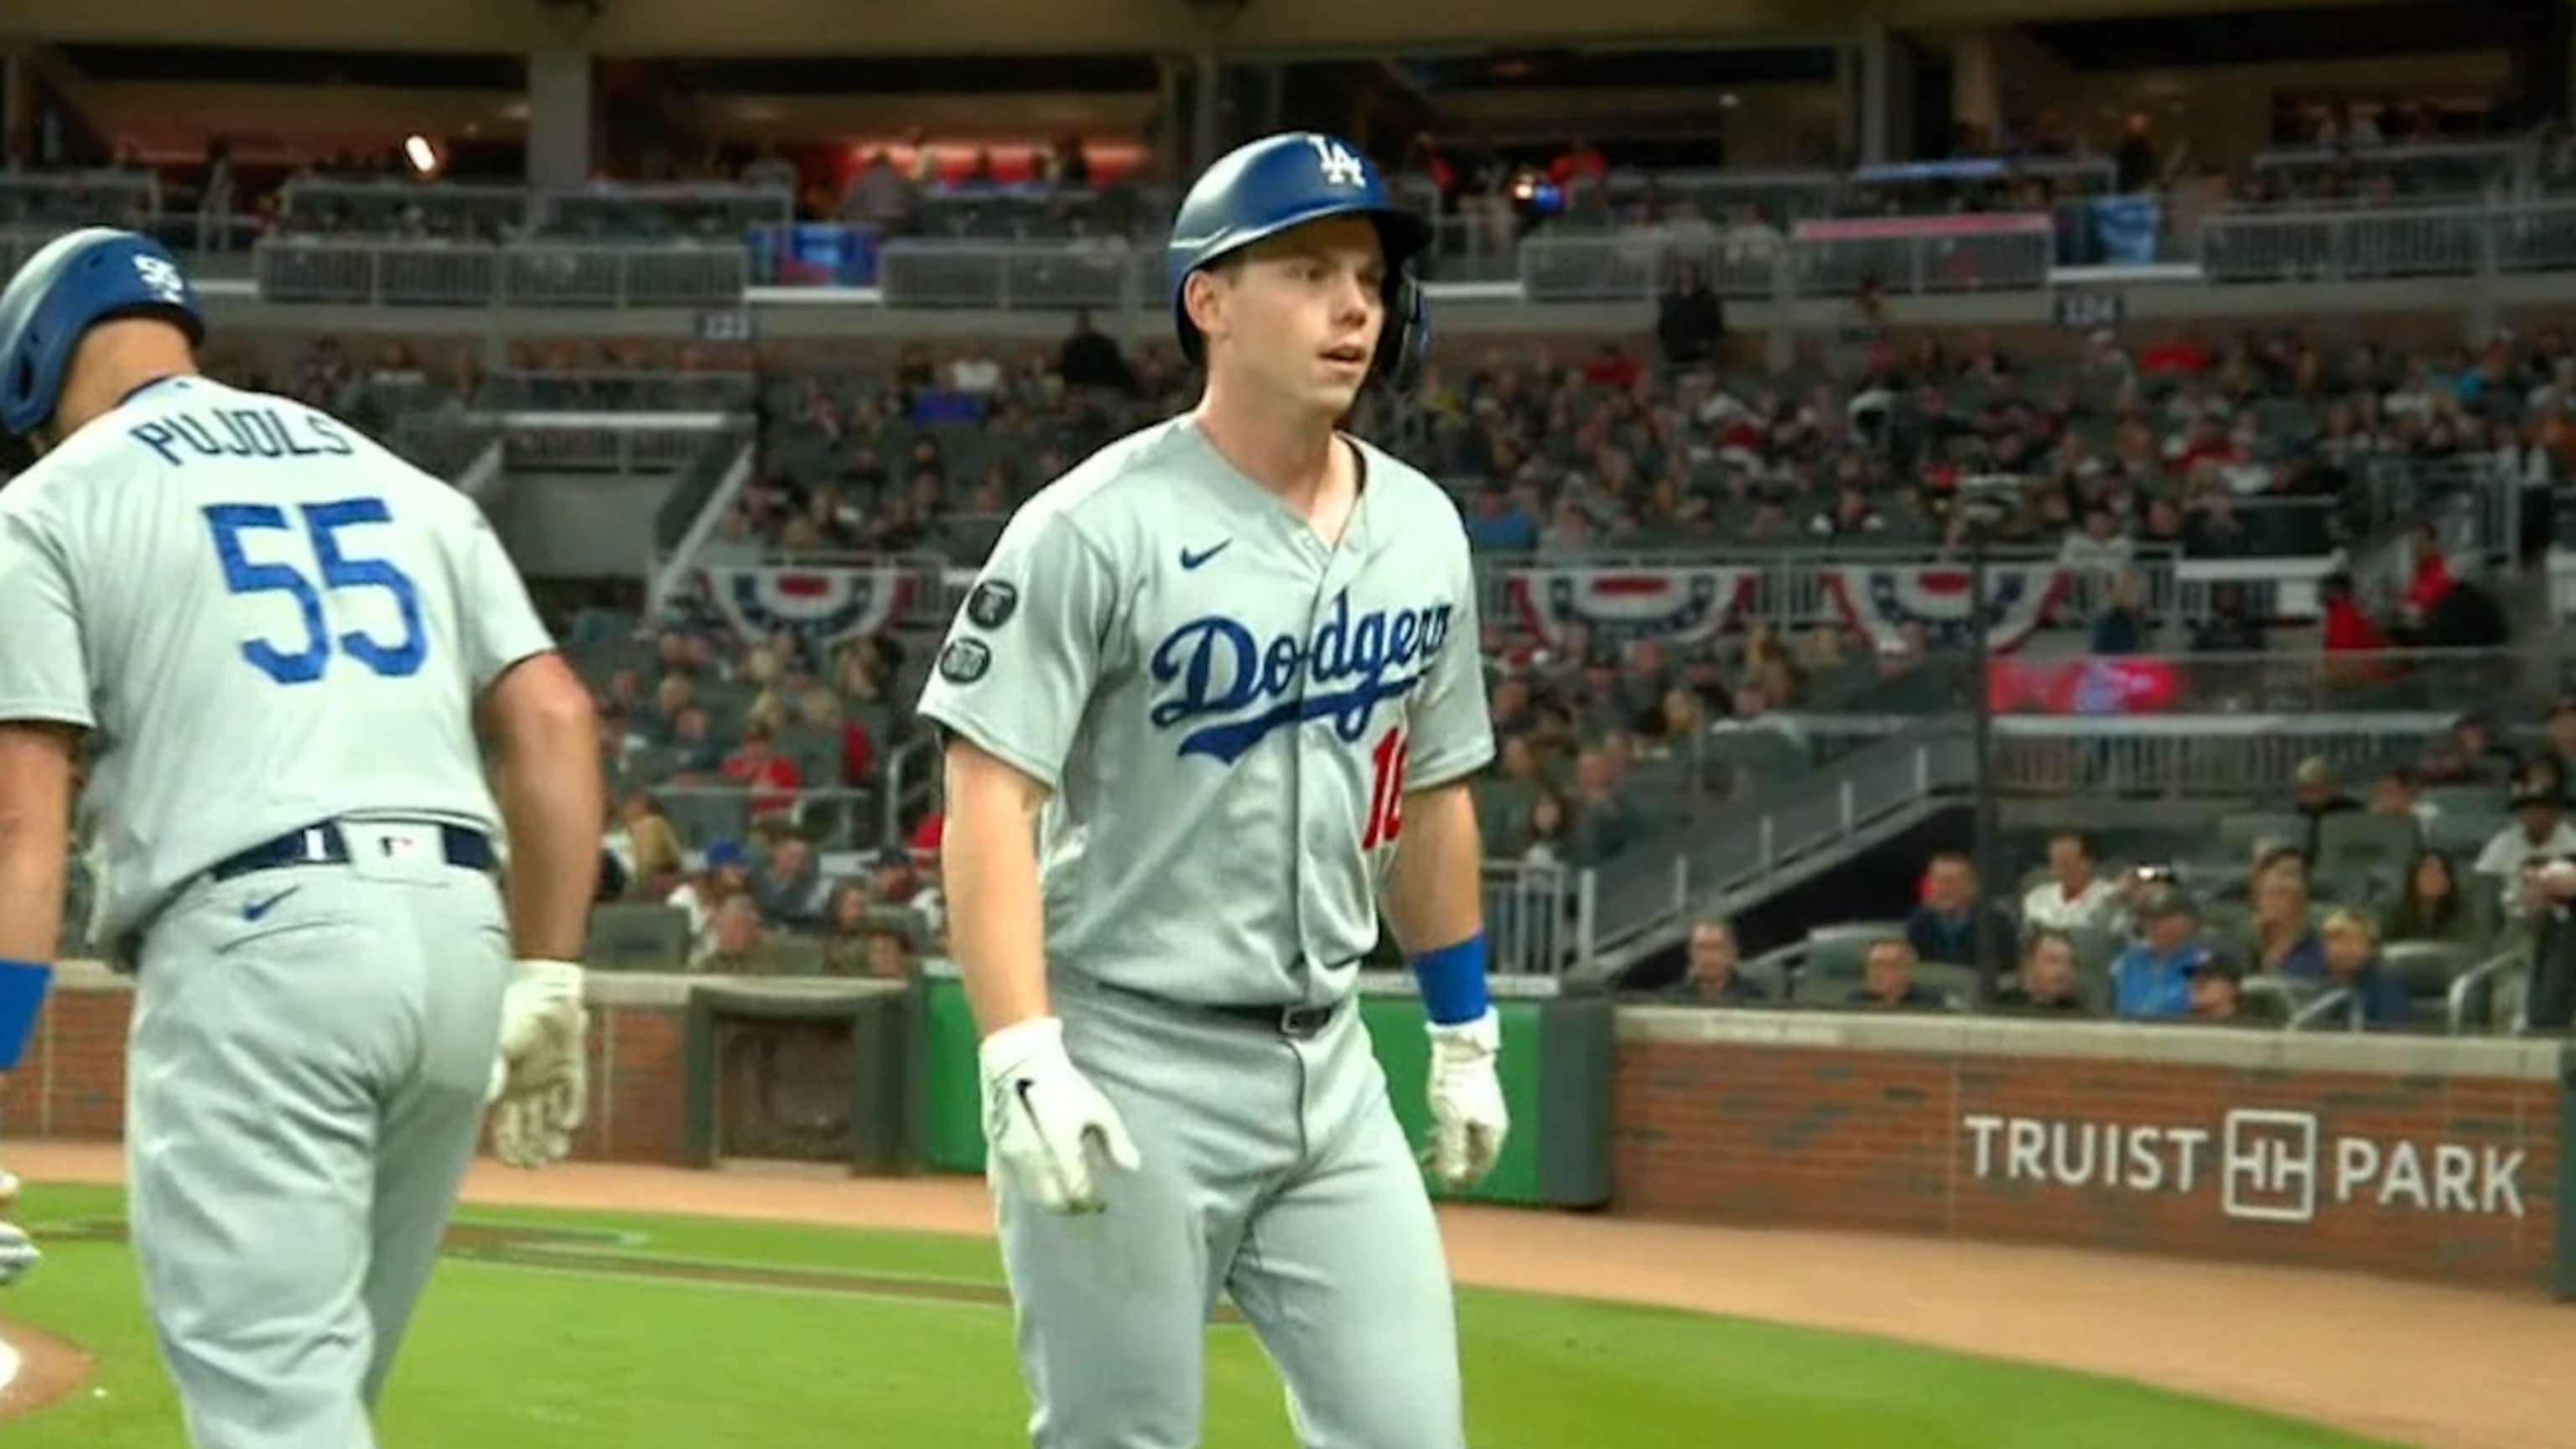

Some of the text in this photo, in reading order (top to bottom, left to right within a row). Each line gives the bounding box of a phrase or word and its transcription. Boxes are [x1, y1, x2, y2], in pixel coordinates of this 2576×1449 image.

[1307, 133, 1366, 188] LA
[130, 409, 354, 465] PUJOLS
[201, 497, 427, 685] 55
[1964, 1115, 2209, 1192] TRUIST
[2335, 1137, 2528, 1218] PARK
